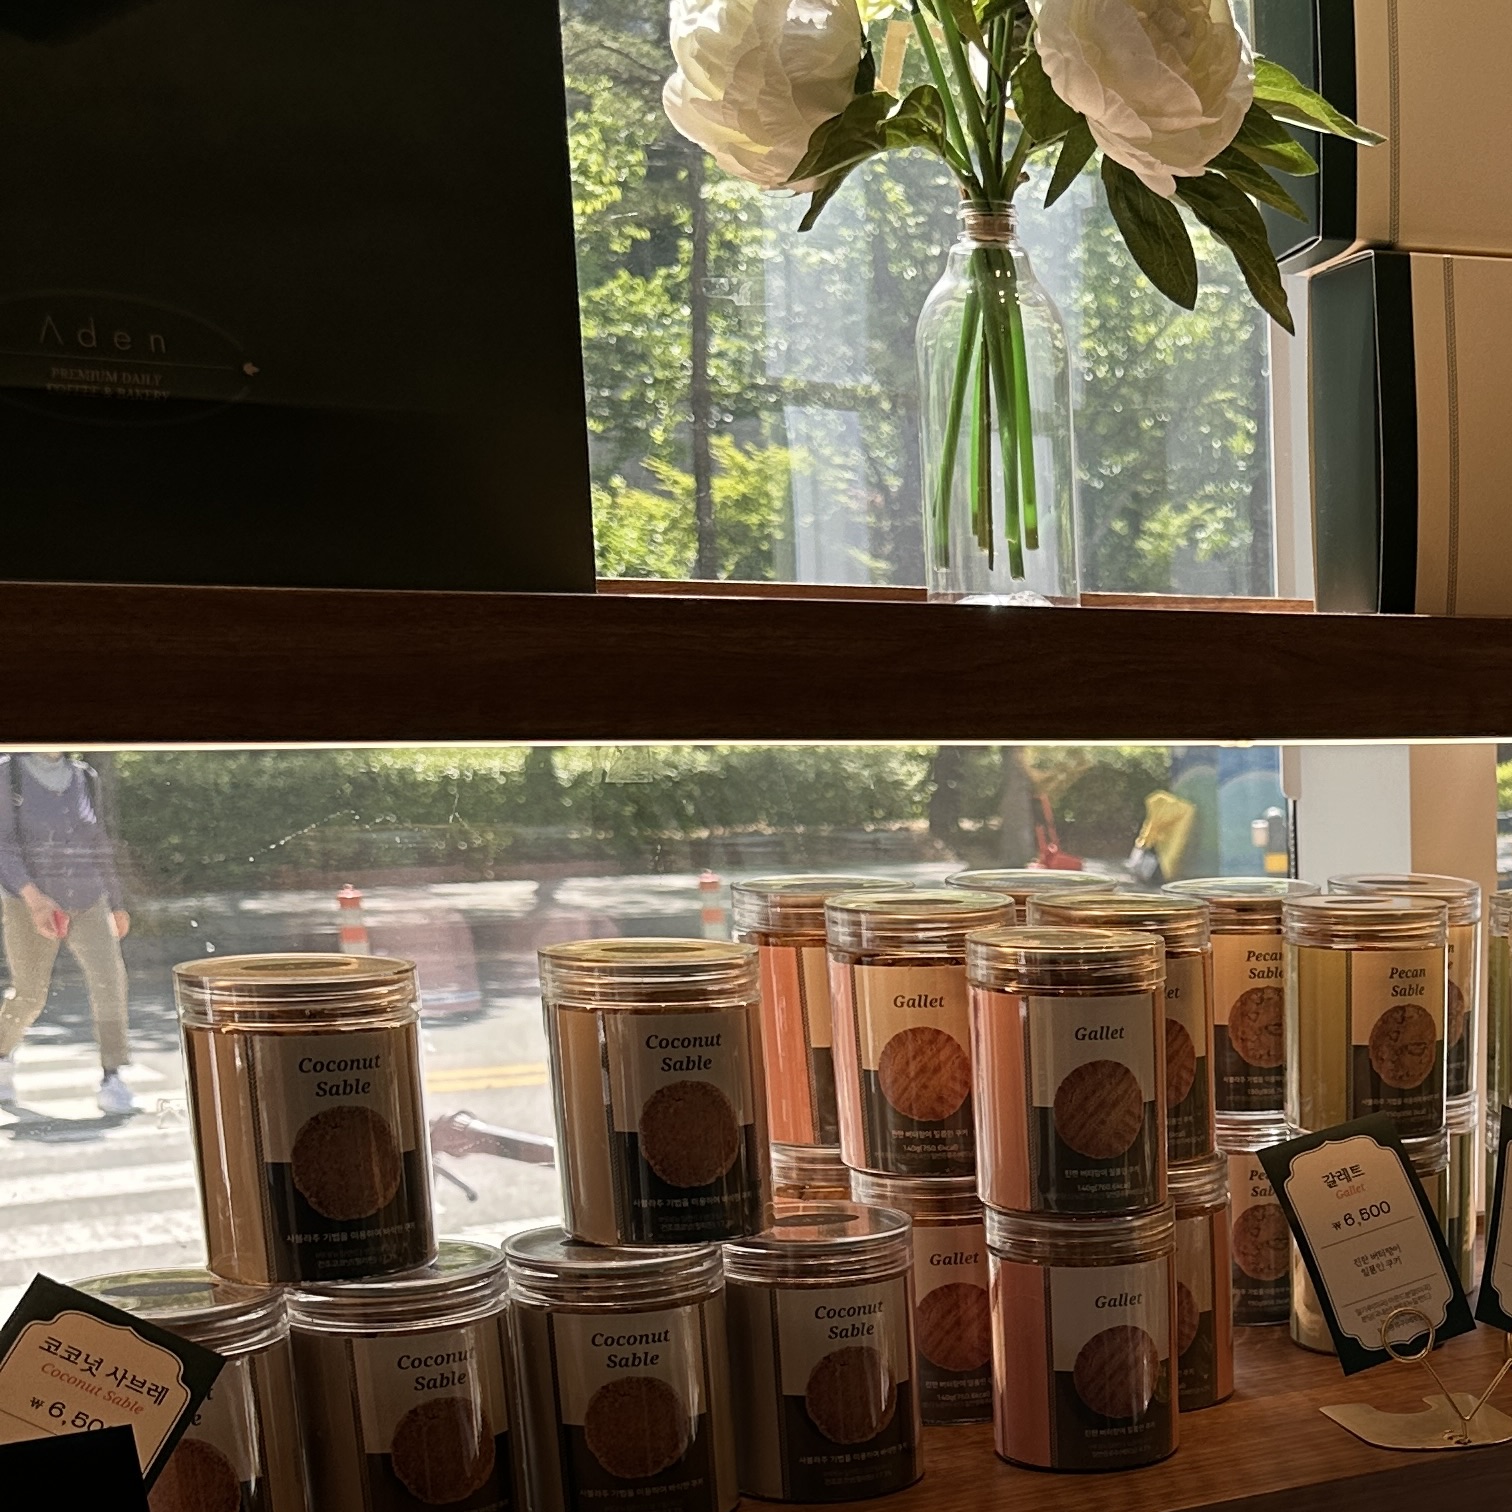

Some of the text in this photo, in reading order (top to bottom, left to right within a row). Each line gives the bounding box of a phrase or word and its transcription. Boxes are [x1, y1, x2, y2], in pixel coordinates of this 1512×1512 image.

[1388, 967, 1427, 979] Pecan
[1390, 984, 1425, 997] Sable
[893, 994, 945, 1008] Gallet
[645, 1033, 722, 1049] Coconut
[1074, 1026, 1125, 1040] Gallet
[298, 1054, 382, 1073] Coconut
[660, 1056, 712, 1072] Sable
[315, 1078, 371, 1097] Sable
[1321, 1164, 1366, 1189] 갈레트
[1335, 1183, 1367, 1200] Gallet
[1343, 1200, 1392, 1227] 6,500
[929, 1252, 979, 1266] Gallet
[1094, 1293, 1143, 1308] Gallet
[815, 1302, 884, 1319] Coconut
[591, 1329, 671, 1347] Coconut
[828, 1322, 875, 1339] Sable
[397, 1346, 475, 1370] Coconut
[606, 1352, 660, 1369] Sable
[38, 1336, 104, 1377] 코코넛
[105, 1366, 170, 1406] 사브레
[40, 1362, 145, 1415] Coconut Sable
[413, 1371, 467, 1391] Sable
[48, 1402, 113, 1431] 6,50
